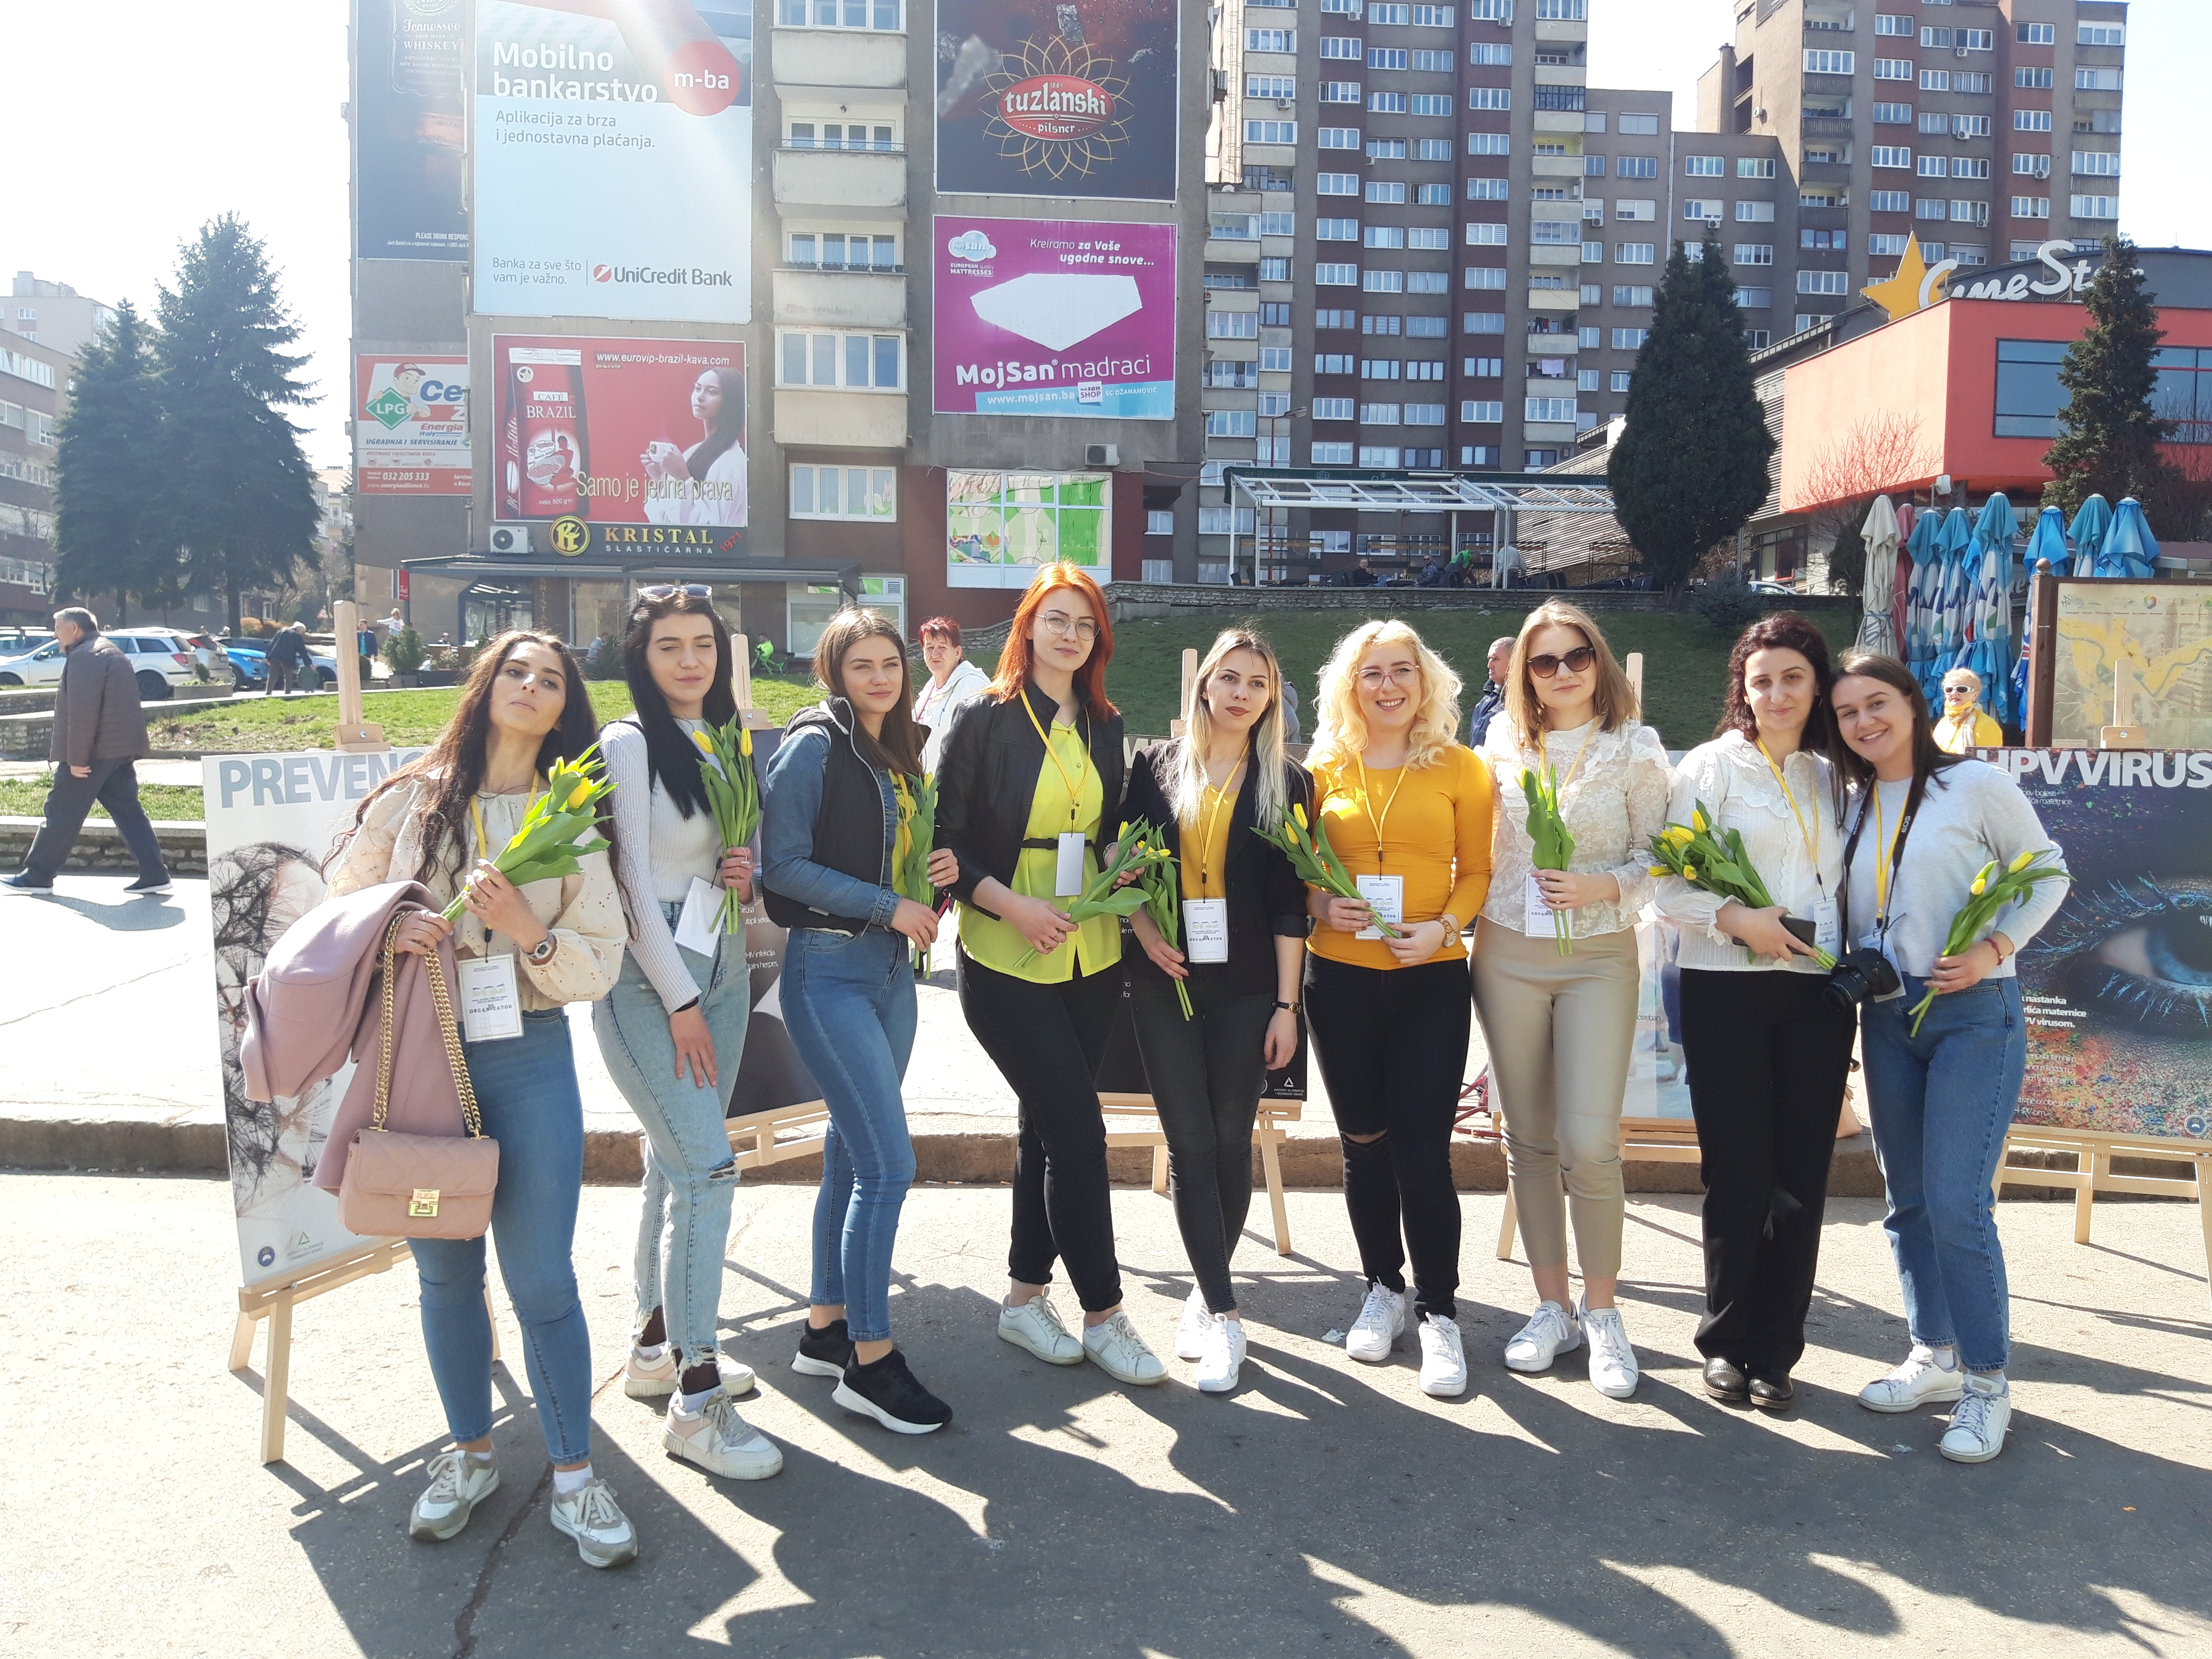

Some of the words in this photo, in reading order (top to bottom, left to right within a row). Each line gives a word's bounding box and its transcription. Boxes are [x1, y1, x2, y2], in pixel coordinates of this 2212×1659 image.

[403, 19, 460, 32] Tennessee
[404, 40, 461, 50] WHISKEY
[493, 42, 613, 71] Mobilno
[674, 69, 730, 91] m-ba
[493, 71, 658, 103] bankarstvo
[1004, 82, 1106, 115] tuzlanski
[496, 110, 563, 127] Aplikacija
[567, 115, 582, 125] za
[587, 114, 616, 127] brza
[1037, 122, 1075, 133] pilsner
[496, 129, 499, 141] i
[502, 130, 589, 144] jednostavna
[594, 133, 655, 150] plaćanja.
[1030, 239, 1075, 249] Kreiramo
[1094, 240, 1120, 251] Vaše
[493, 258, 525, 270] Banka
[529, 261, 540, 270] za
[544, 262, 562, 270] sve
[565, 259, 581, 271] što
[1060, 253, 1104, 266] ugodne
[1108, 255, 1154, 266] snove...
[493, 274, 517, 283] vam
[519, 273, 529, 285] je
[533, 272, 567, 285] važno.
[614, 266, 687, 285] UniCredit
[692, 269, 733, 287] Bank
[1919, 240, 2144, 308] CineSt
[597, 353, 730, 366] www.eurovip-brazil-kava.com
[1062, 355, 1151, 379] madraci
[987, 391, 1075, 405] www.mojsan.ba
[376, 404, 405, 414] LPG
[451, 406, 465, 421] Z
[526, 406, 577, 419] BRAZIL
[420, 423, 464, 432] Energia
[383, 472, 397, 481] 032
[398, 472, 414, 481] 205
[415, 472, 430, 481] 333
[577, 471, 622, 497] Samo
[625, 472, 639, 503] je
[644, 472, 686, 504] jedna
[692, 479, 733, 505] prava
[604, 527, 714, 544] KRISTAL
[720, 531, 743, 553] 1971
[605, 544, 714, 555] SLASTIČARNA
[2074, 751, 2212, 789] VIRUS
[1901, 816, 1911, 833] EOS
[756, 949, 775, 958] infekcija
[2025, 996, 2067, 1005] nastanka
[469, 1004, 512, 1013] ORGANIZATOR
[2023, 1005, 2042, 1014] rlića
[2042, 1009, 2087, 1017] maternice
[2024, 1016, 2036, 1025] PV
[2036, 1018, 2076, 1028] virusom.
